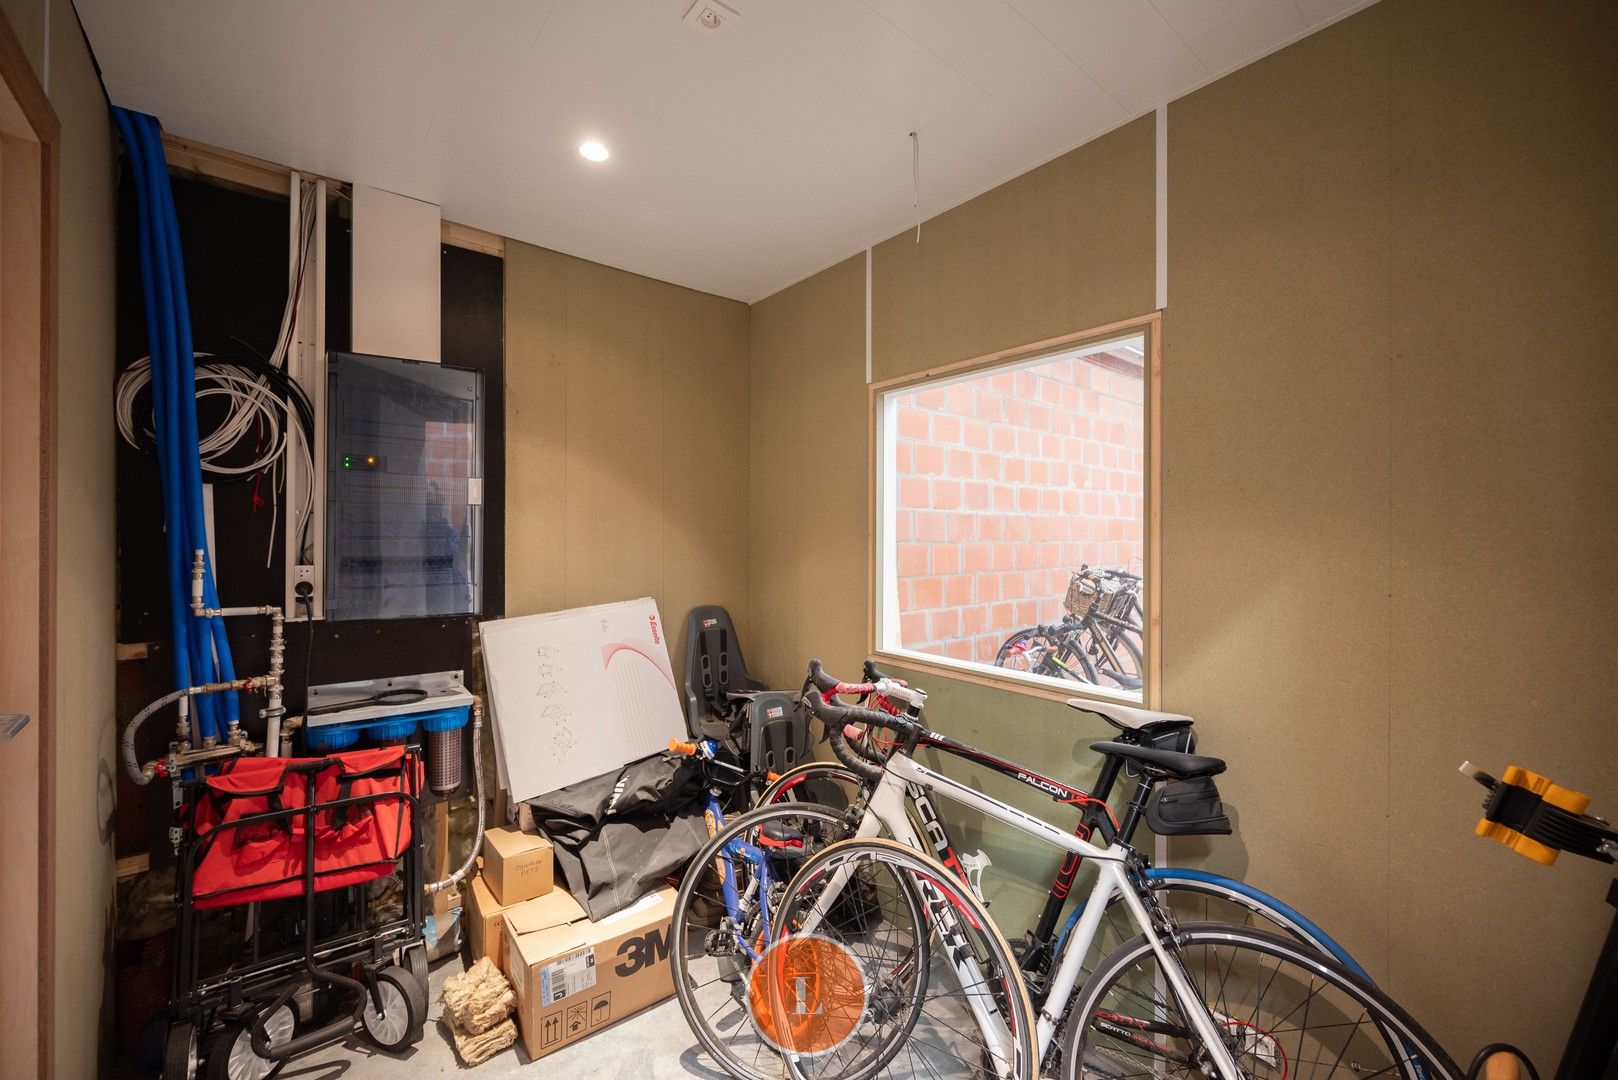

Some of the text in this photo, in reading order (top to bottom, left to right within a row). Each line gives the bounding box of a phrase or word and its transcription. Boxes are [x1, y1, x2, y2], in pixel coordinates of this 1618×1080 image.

[1017, 772, 1068, 798] FALCON
[906, 781, 970, 889] SCAT
[908, 836, 968, 970] REK
[614, 923, 672, 977] 3M
[1100, 1022, 1131, 1037] SCATTO
